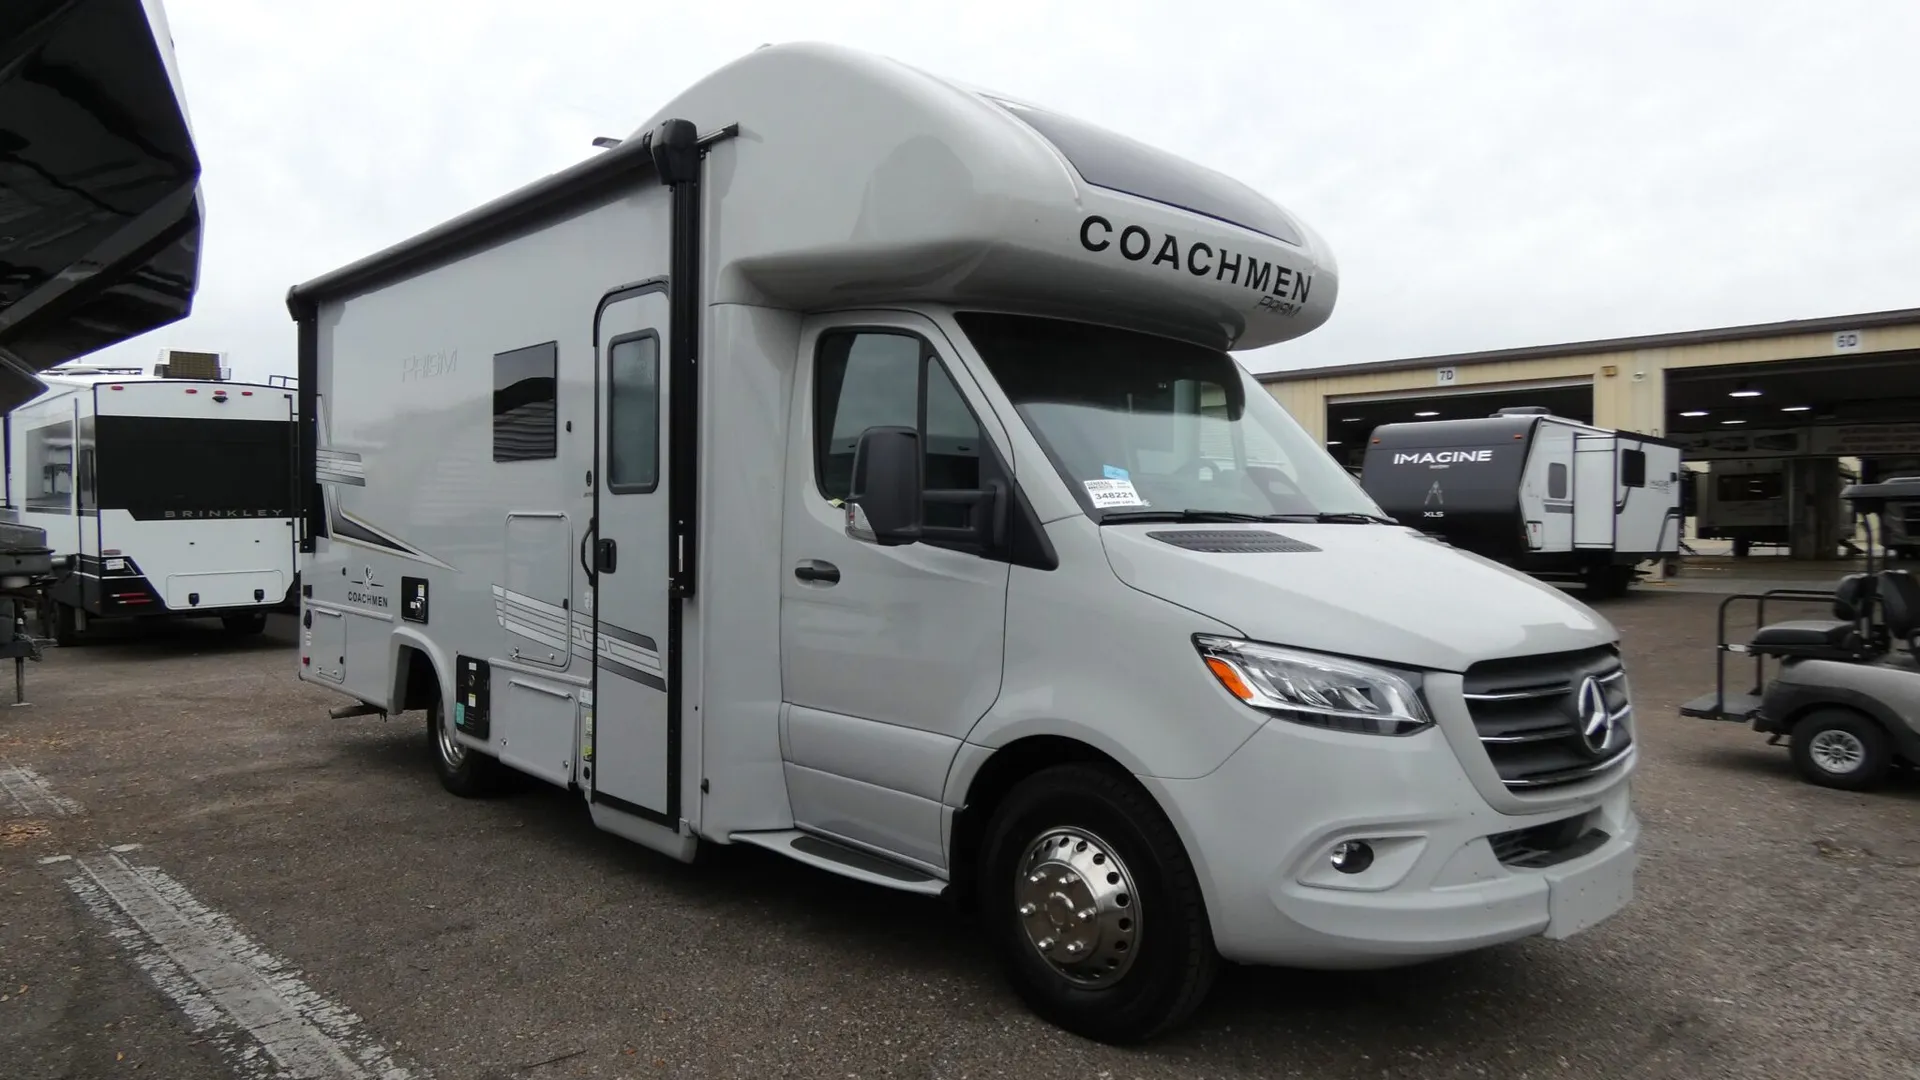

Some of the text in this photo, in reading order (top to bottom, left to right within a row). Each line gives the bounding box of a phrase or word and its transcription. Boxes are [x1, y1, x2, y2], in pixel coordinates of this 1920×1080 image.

[1079, 215, 1312, 304] COACHMEN
[401, 348, 458, 383] PRISM
[1439, 370, 1454, 381] 7D
[1393, 450, 1494, 465] IMAGINE
[1094, 491, 1135, 501] 348221
[164, 509, 284, 518] BRINKLEY
[347, 591, 389, 608] COACHMEN
